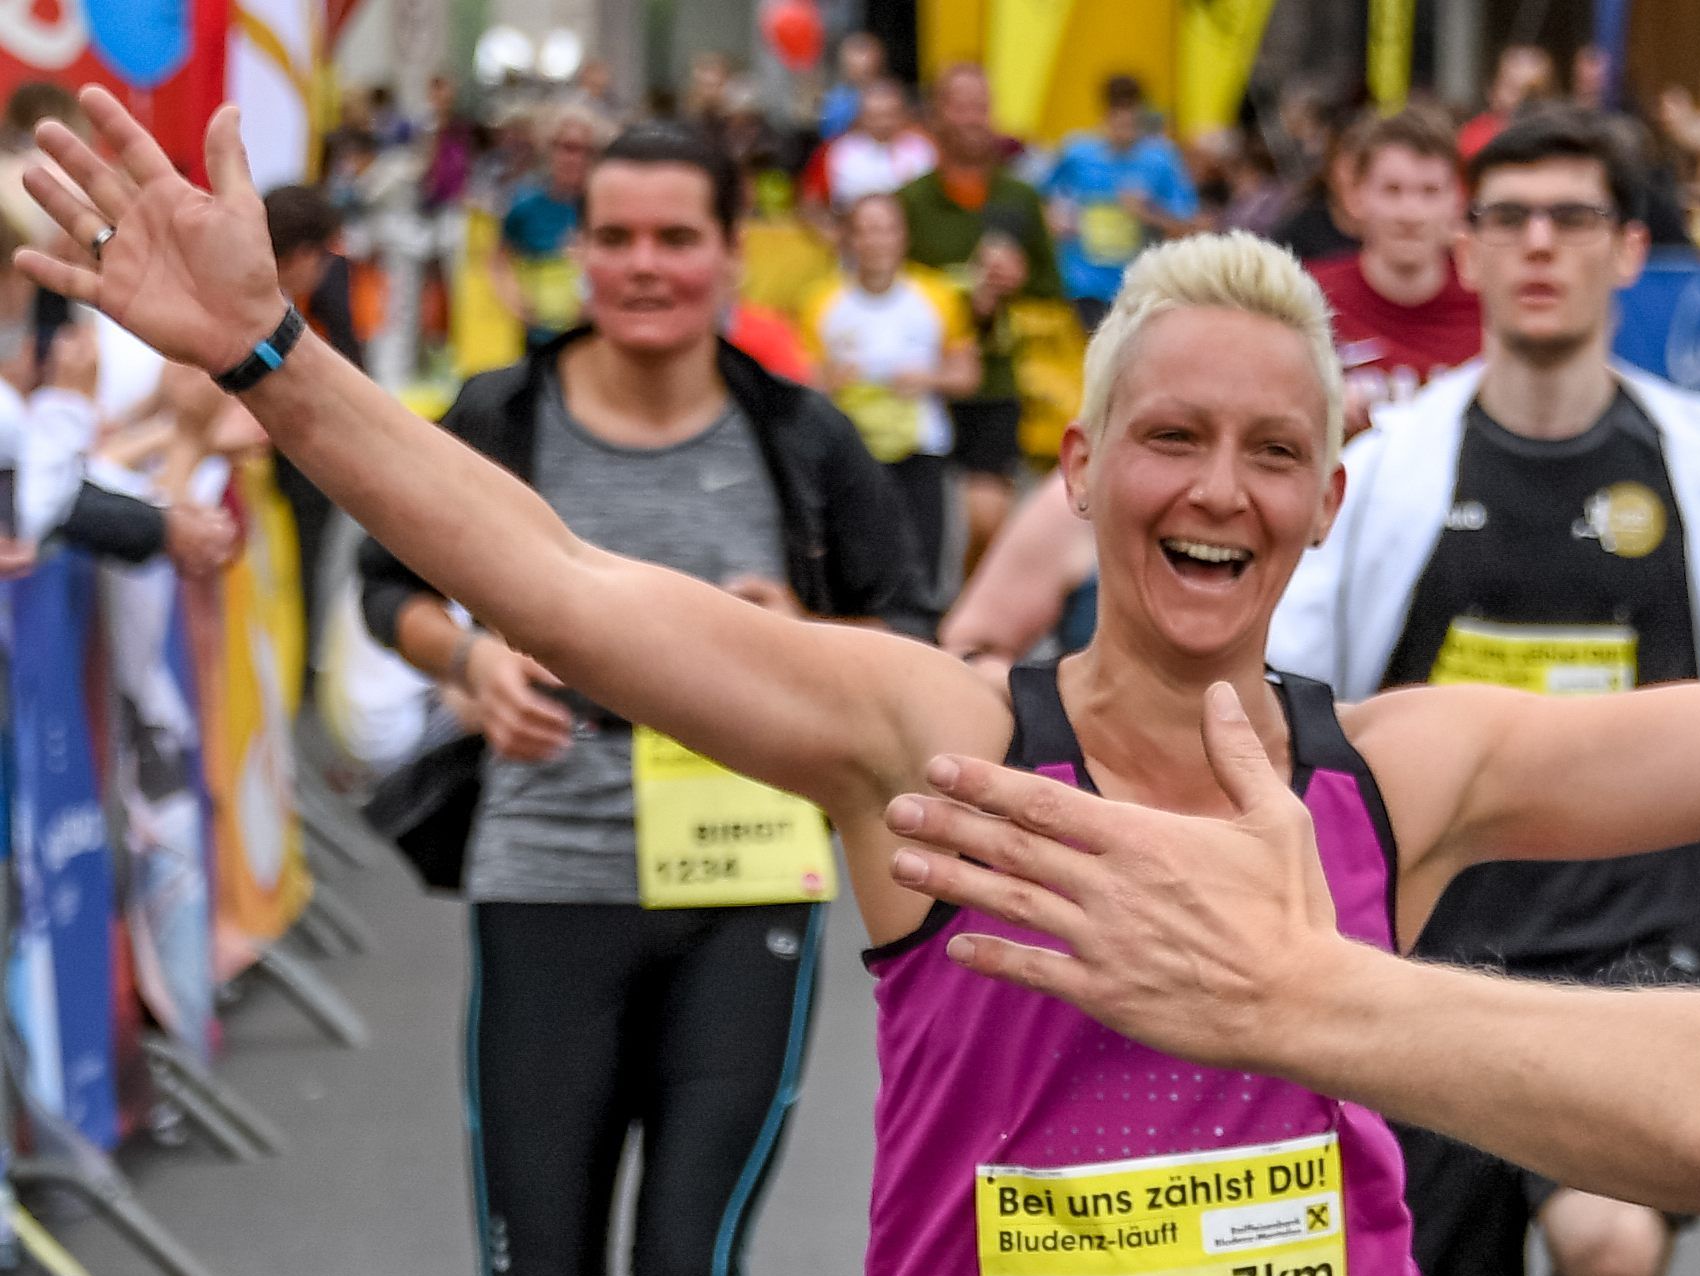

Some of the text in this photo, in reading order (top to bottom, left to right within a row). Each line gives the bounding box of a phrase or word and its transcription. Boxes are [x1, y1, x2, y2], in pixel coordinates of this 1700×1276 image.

[998, 1156, 1327, 1218] Bei uns zählst DU!
[999, 1221, 1178, 1253] Bludenz-läuft
